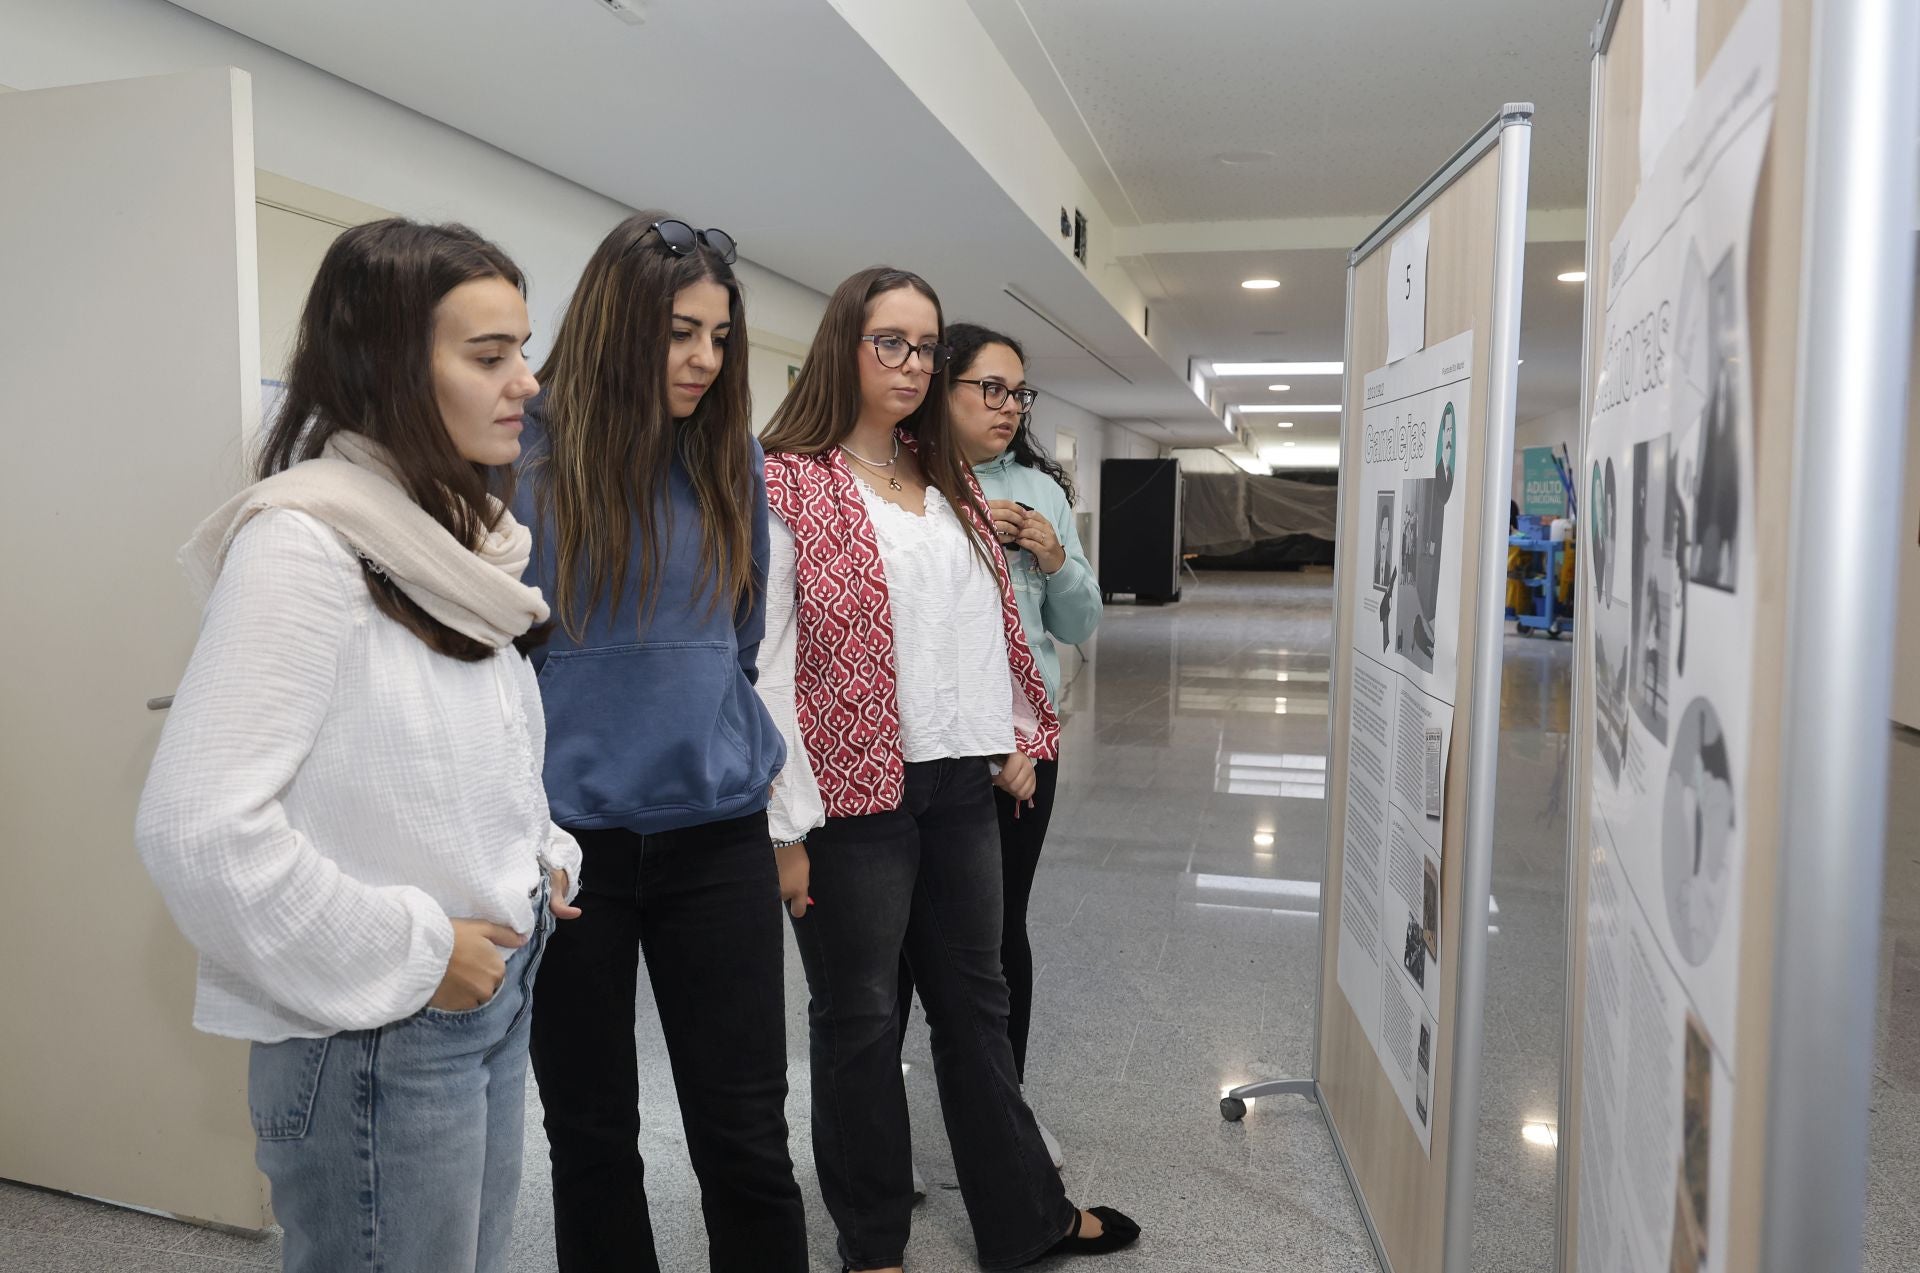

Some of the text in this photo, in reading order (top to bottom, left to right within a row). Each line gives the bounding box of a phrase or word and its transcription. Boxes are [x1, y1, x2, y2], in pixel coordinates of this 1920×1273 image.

[1405, 263, 1411, 300] 5
[1365, 413, 1427, 471] Canalejas
[1526, 480, 1562, 494] ADULTO
